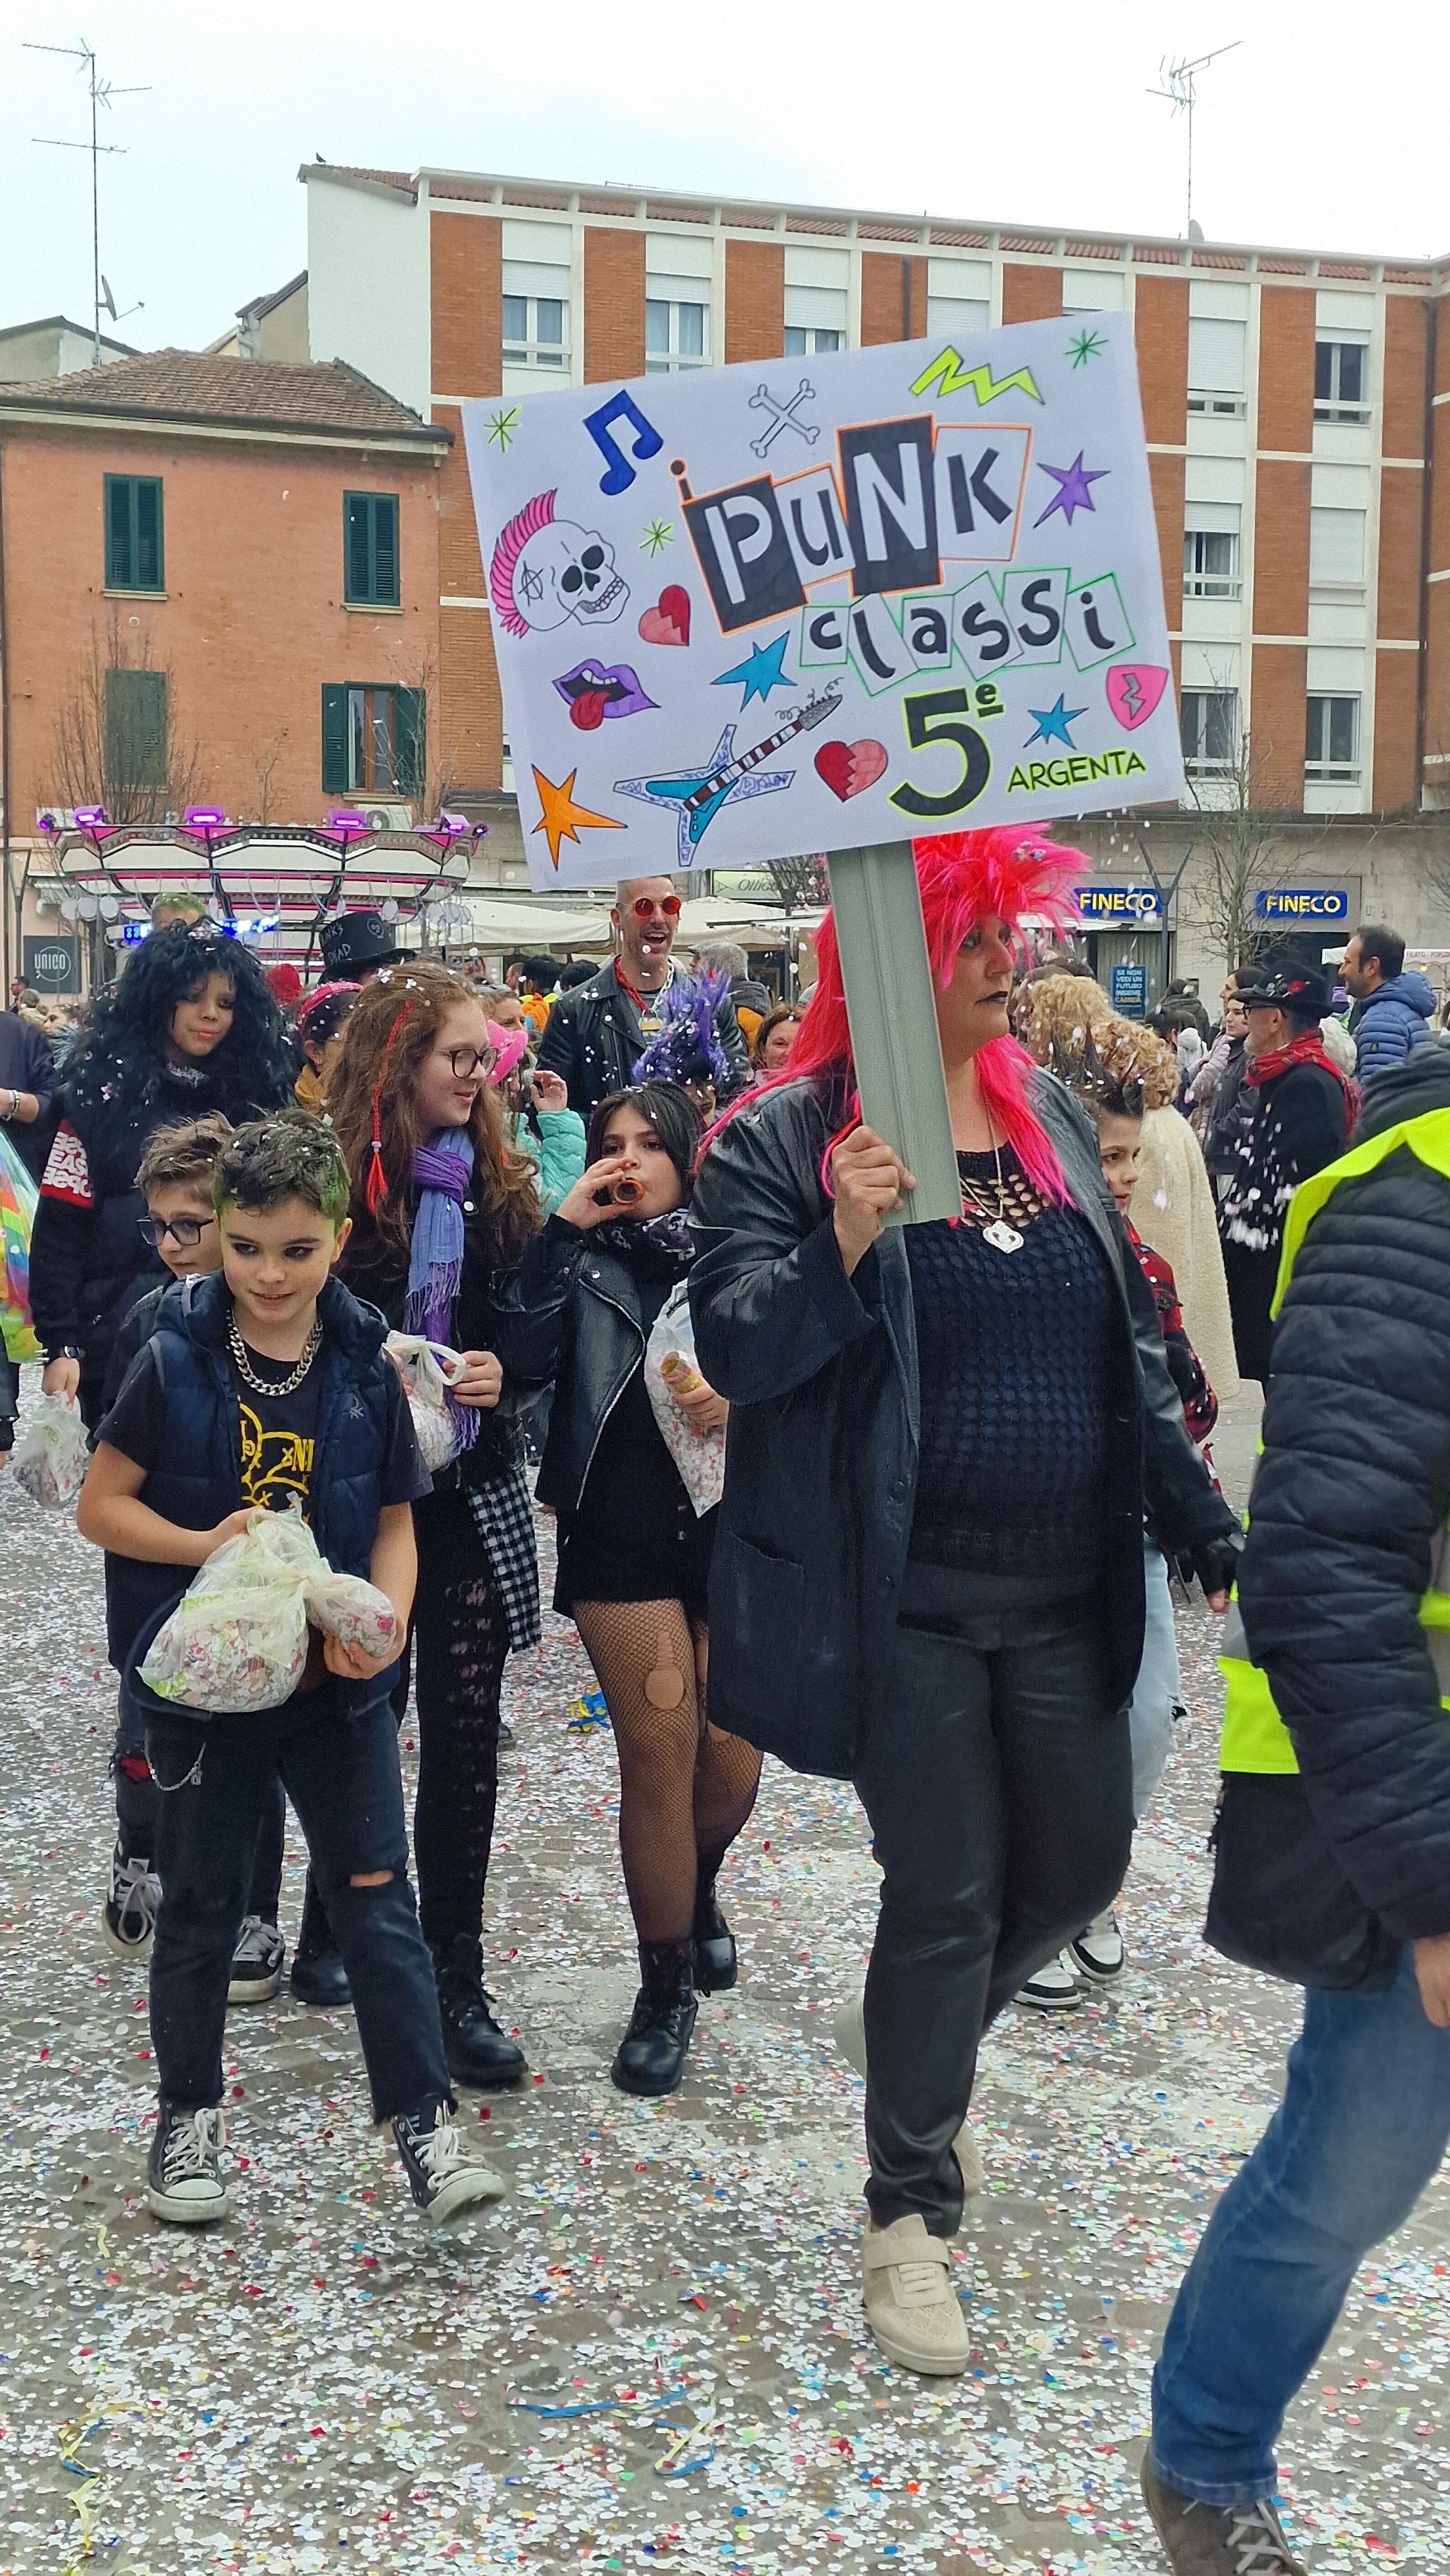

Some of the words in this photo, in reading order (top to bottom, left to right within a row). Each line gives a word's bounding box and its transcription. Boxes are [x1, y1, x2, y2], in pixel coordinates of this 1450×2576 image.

[1007, 750, 1147, 793] ARGENTA
[1079, 893, 1156, 911] FINECO
[1266, 895, 1341, 913] FINECO
[34, 953, 66, 970] UNICO
